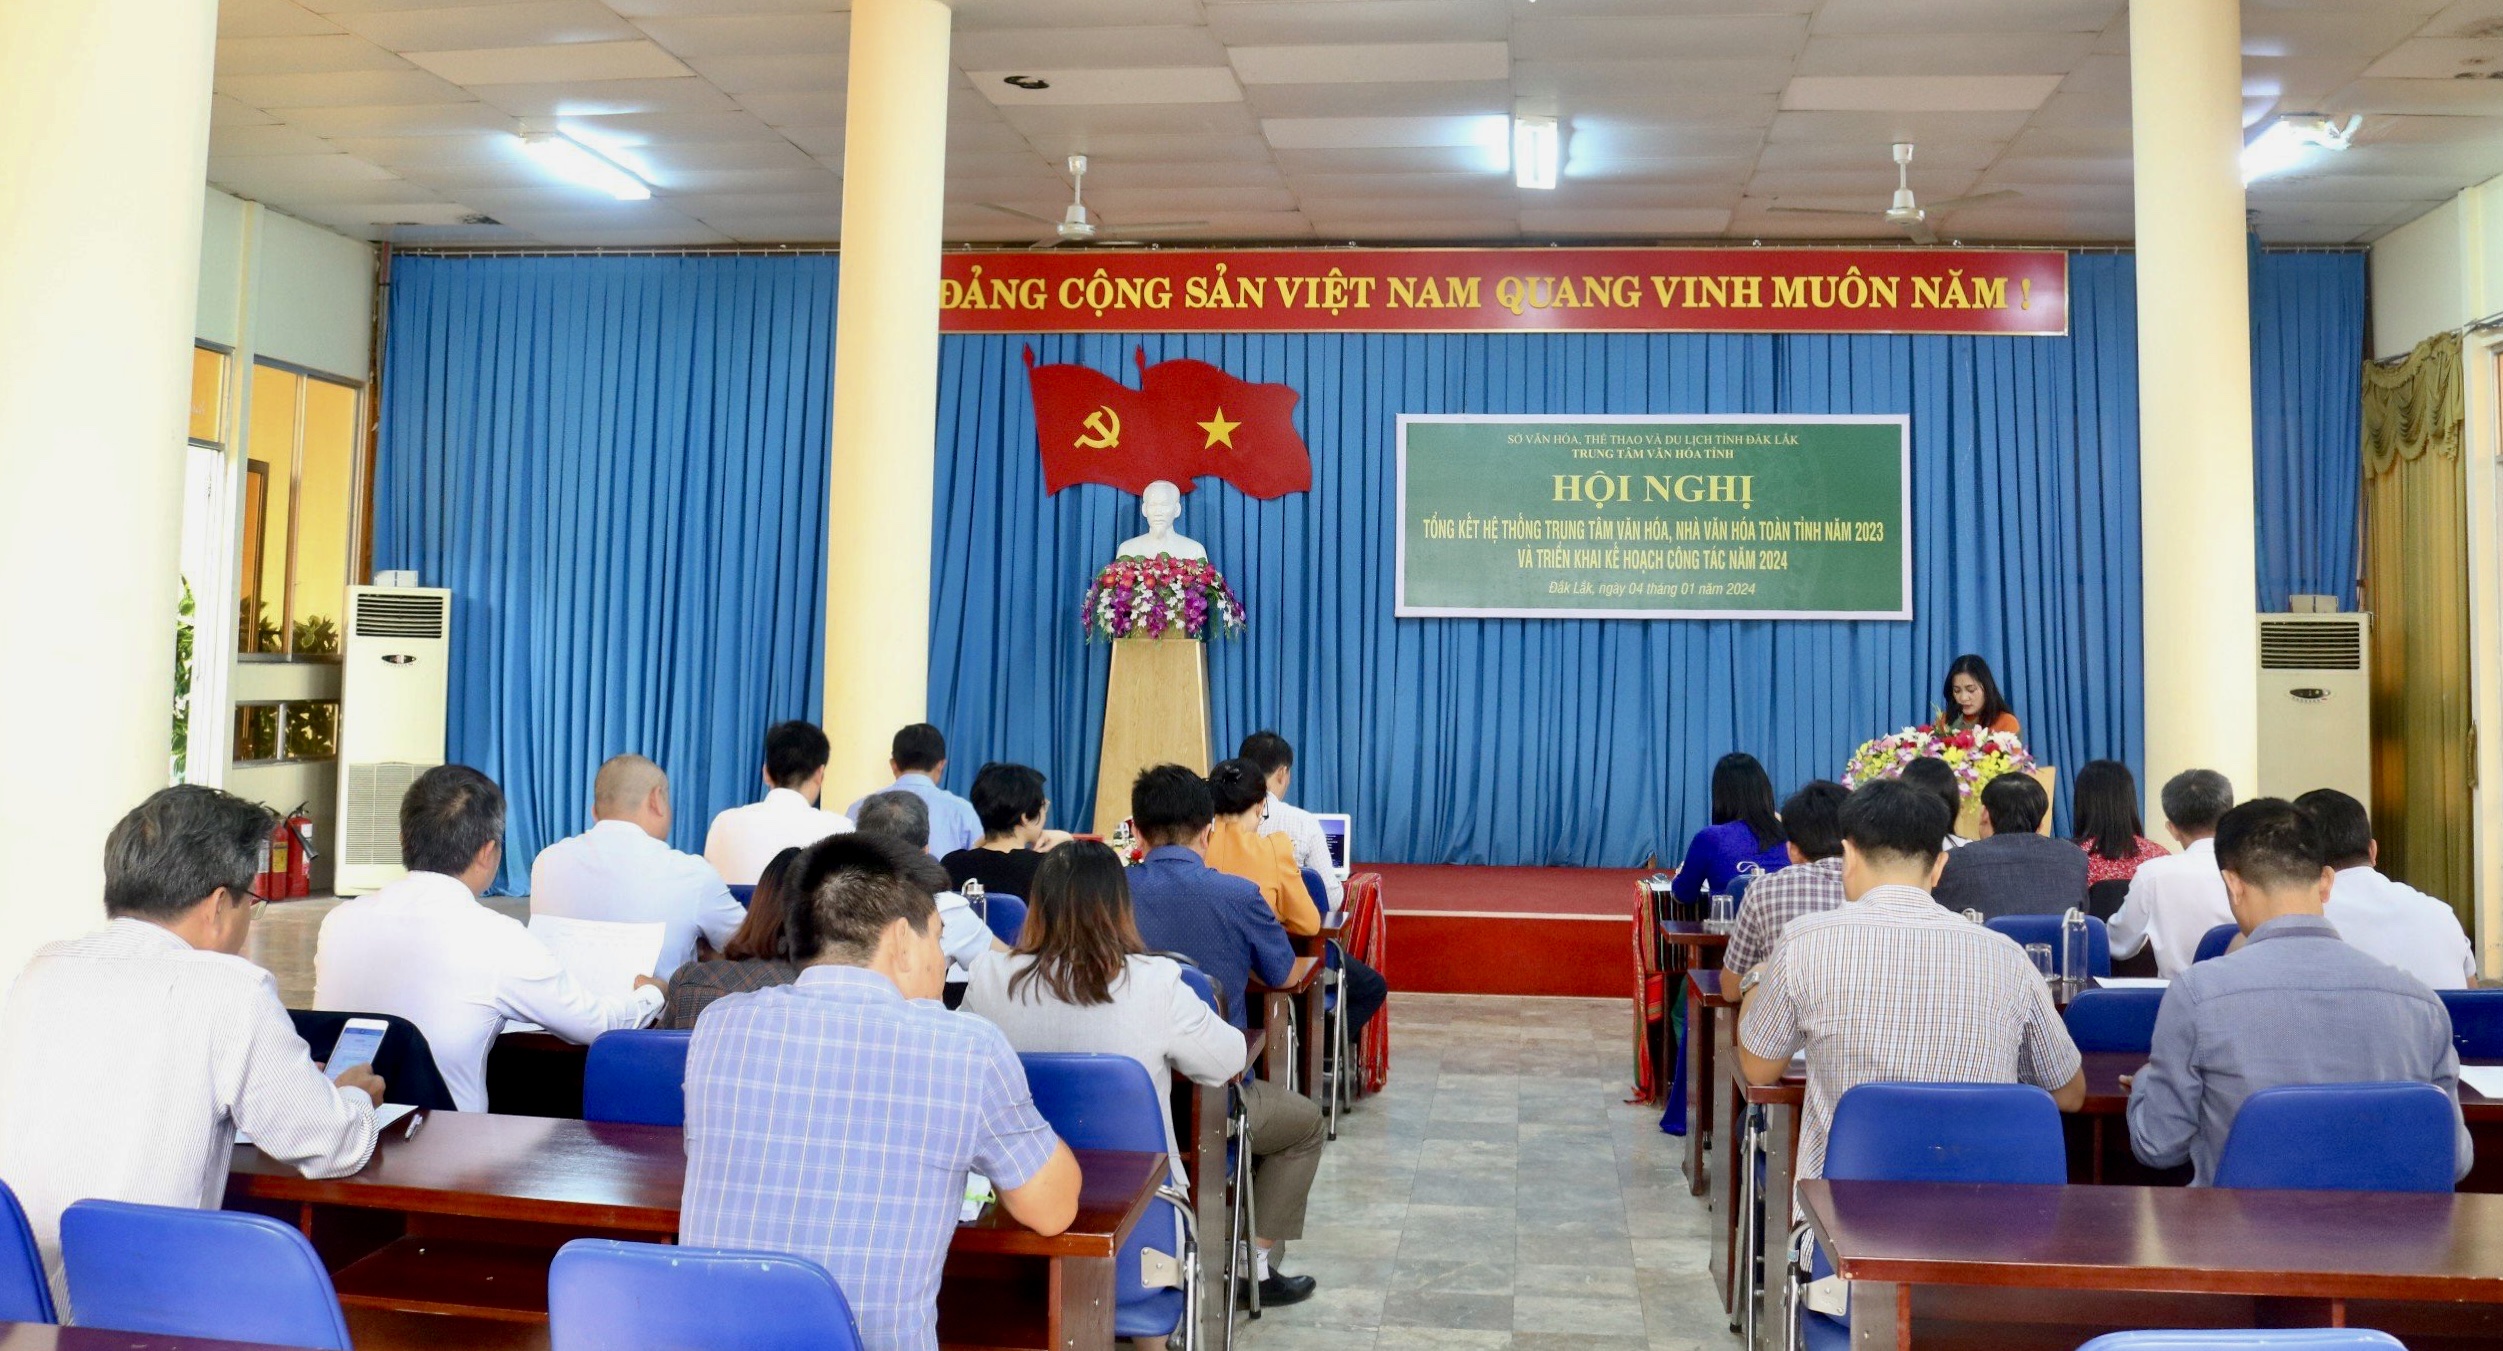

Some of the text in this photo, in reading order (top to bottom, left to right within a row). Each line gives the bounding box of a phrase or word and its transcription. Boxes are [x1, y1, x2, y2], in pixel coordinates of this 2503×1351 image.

[940, 265, 1048, 309] ĐẢNG
[1058, 268, 1173, 316] CỘNG
[1186, 263, 1267, 309] SẢN
[1274, 267, 1375, 316] VIỆT
[1386, 276, 1481, 309] NAM
[1495, 276, 1642, 315] QUANG
[1651, 276, 1762, 309] VINH
[1771, 266, 1900, 309] MUÔN
[1910, 269, 2008, 309] NĂM
[1525, 432, 1550, 444] VĂN
[1610, 435, 1643, 444] THAO
[1645, 433, 1662, 444] VÀ
[1665, 435, 1681, 444] DU
[1685, 435, 1712, 446] LỊCH
[1715, 432, 1743, 444] TỈNH
[1572, 449, 1614, 458] TRUNG
[1616, 447, 1644, 458] TÂM
[1647, 448, 1672, 458] VĂN
[1704, 446, 1734, 458] TỈNH
[1552, 470, 1754, 510] HỘI NGHỊ
[1423, 512, 1884, 544] TỔNG KẾT HỆ THỐNG TRUNG TÂM VĂN HÓA, NHÀ VĂN HÓA TOÀN TỈNH NĂM 2023
[1518, 541, 1788, 574] VÀ TRIỂN KHAI KẾ HOẠCH CÔNG TÁC NĂM 2024
[1598, 582, 1626, 597] ngày
[1628, 582, 1644, 595] 04
[1646, 582, 1678, 597] tháng
[1681, 582, 1695, 595] 01
[1698, 582, 1723, 595] năm
[1726, 582, 1756, 595] 2024
